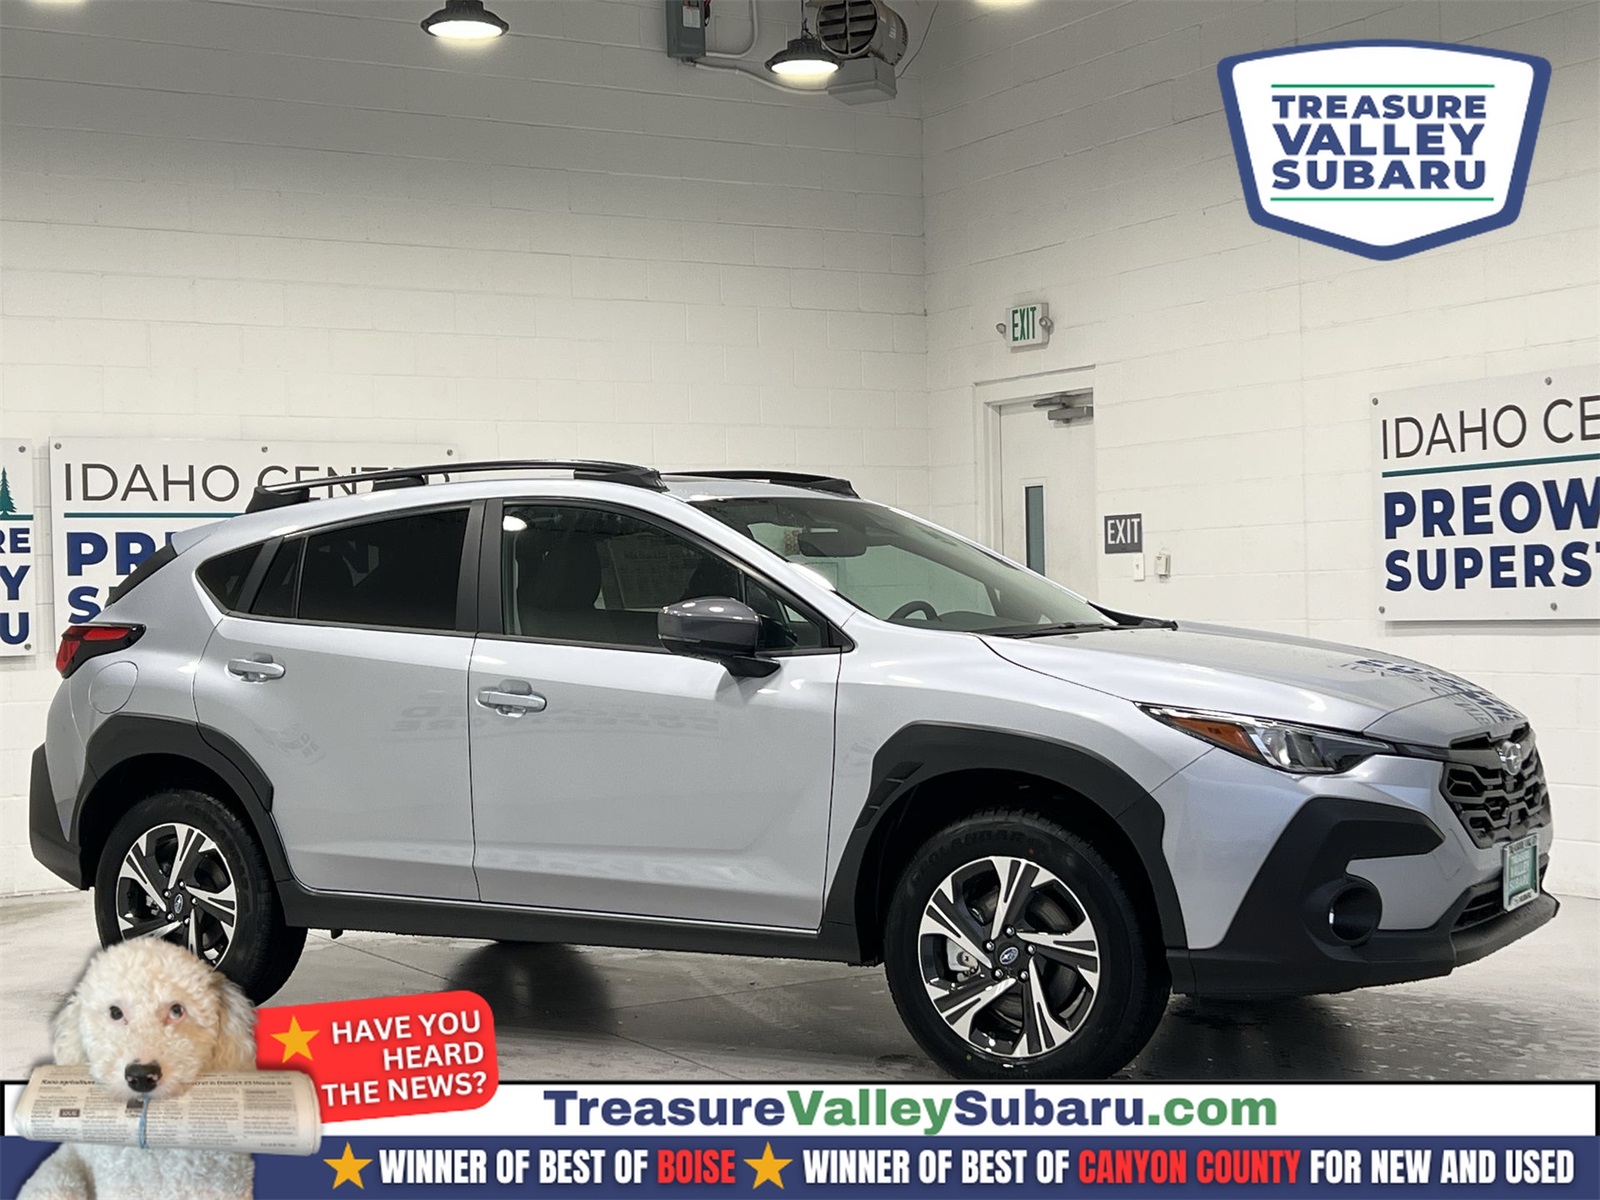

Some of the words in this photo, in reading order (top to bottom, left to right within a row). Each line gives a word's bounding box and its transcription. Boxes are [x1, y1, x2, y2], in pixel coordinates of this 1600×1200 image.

[1011, 306, 1037, 342] EXIT
[1381, 403, 1528, 460] IDAHO
[64, 462, 240, 502] IDAHO
[1107, 518, 1140, 544] EXIT
[66, 531, 178, 577] PR
[1385, 541, 1600, 592] SUPERS
